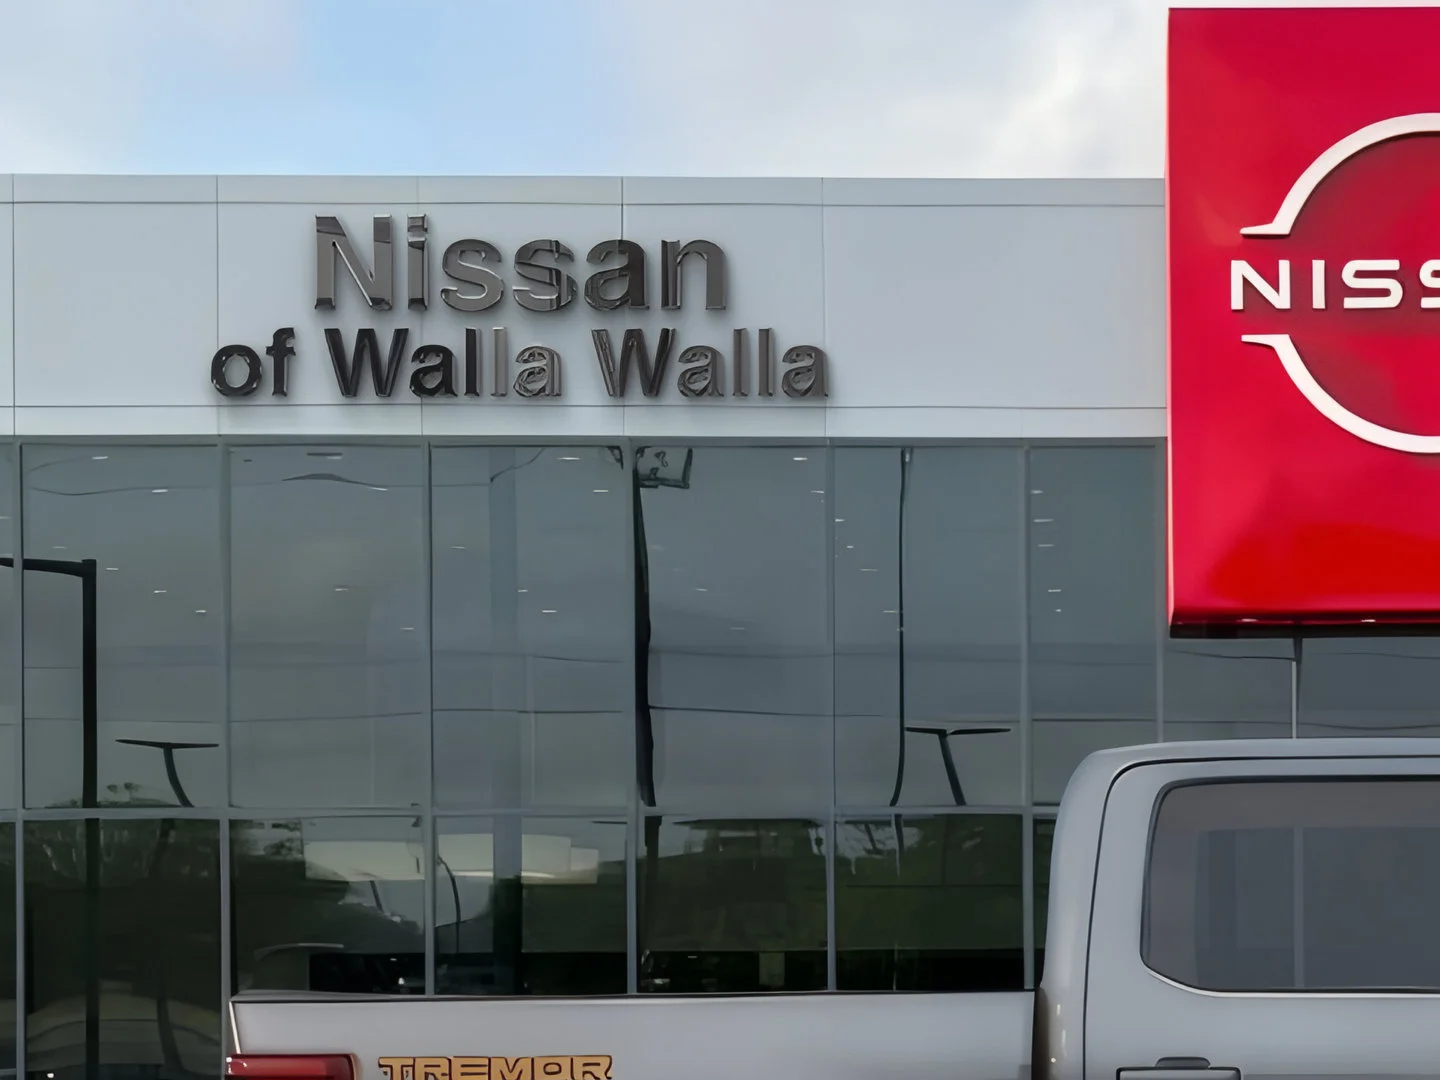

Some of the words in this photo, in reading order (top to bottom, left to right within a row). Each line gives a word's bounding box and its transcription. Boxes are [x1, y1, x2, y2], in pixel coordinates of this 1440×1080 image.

[313, 213, 727, 312] Nissan
[210, 326, 297, 397] of
[323, 326, 562, 398] Walla
[590, 327, 829, 398] Walla
